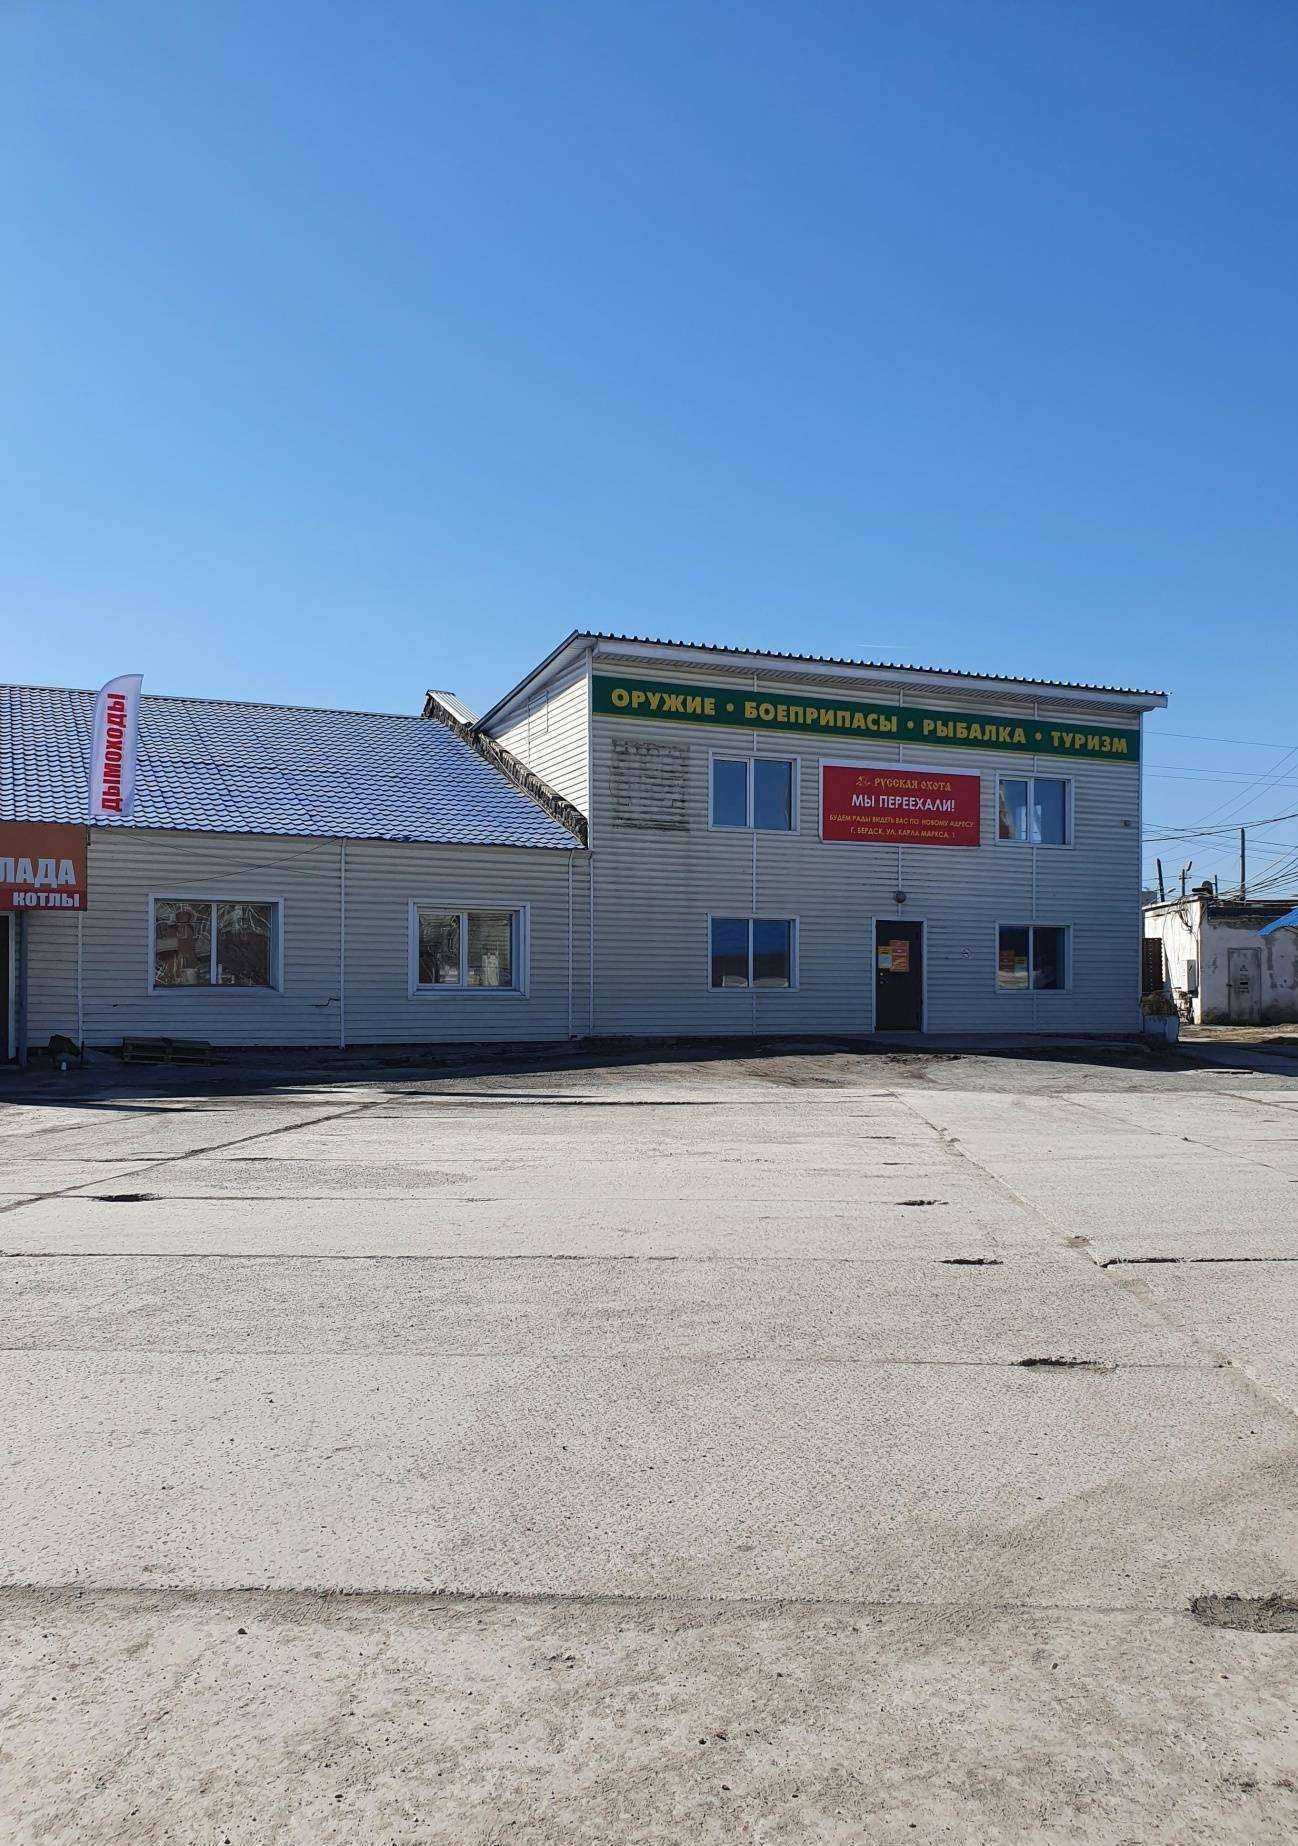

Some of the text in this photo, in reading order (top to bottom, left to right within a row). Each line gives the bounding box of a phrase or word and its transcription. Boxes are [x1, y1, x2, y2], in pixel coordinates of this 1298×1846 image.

[611, 688, 1128, 754] ОРУЖИЕ БОЕПРИПАСЫ РЫБАЛКА ТУРИЗМ
[101, 692, 127, 812] ДЫМОХОДЫ
[874, 777, 952, 792] РУССКАЯ ОХОТА
[852, 794, 955, 812] МЫ ПЕРЕЕХАЛИ!
[829, 814, 851, 822] БУДЕМ
[12, 891, 80, 908] КОТЛЫ
